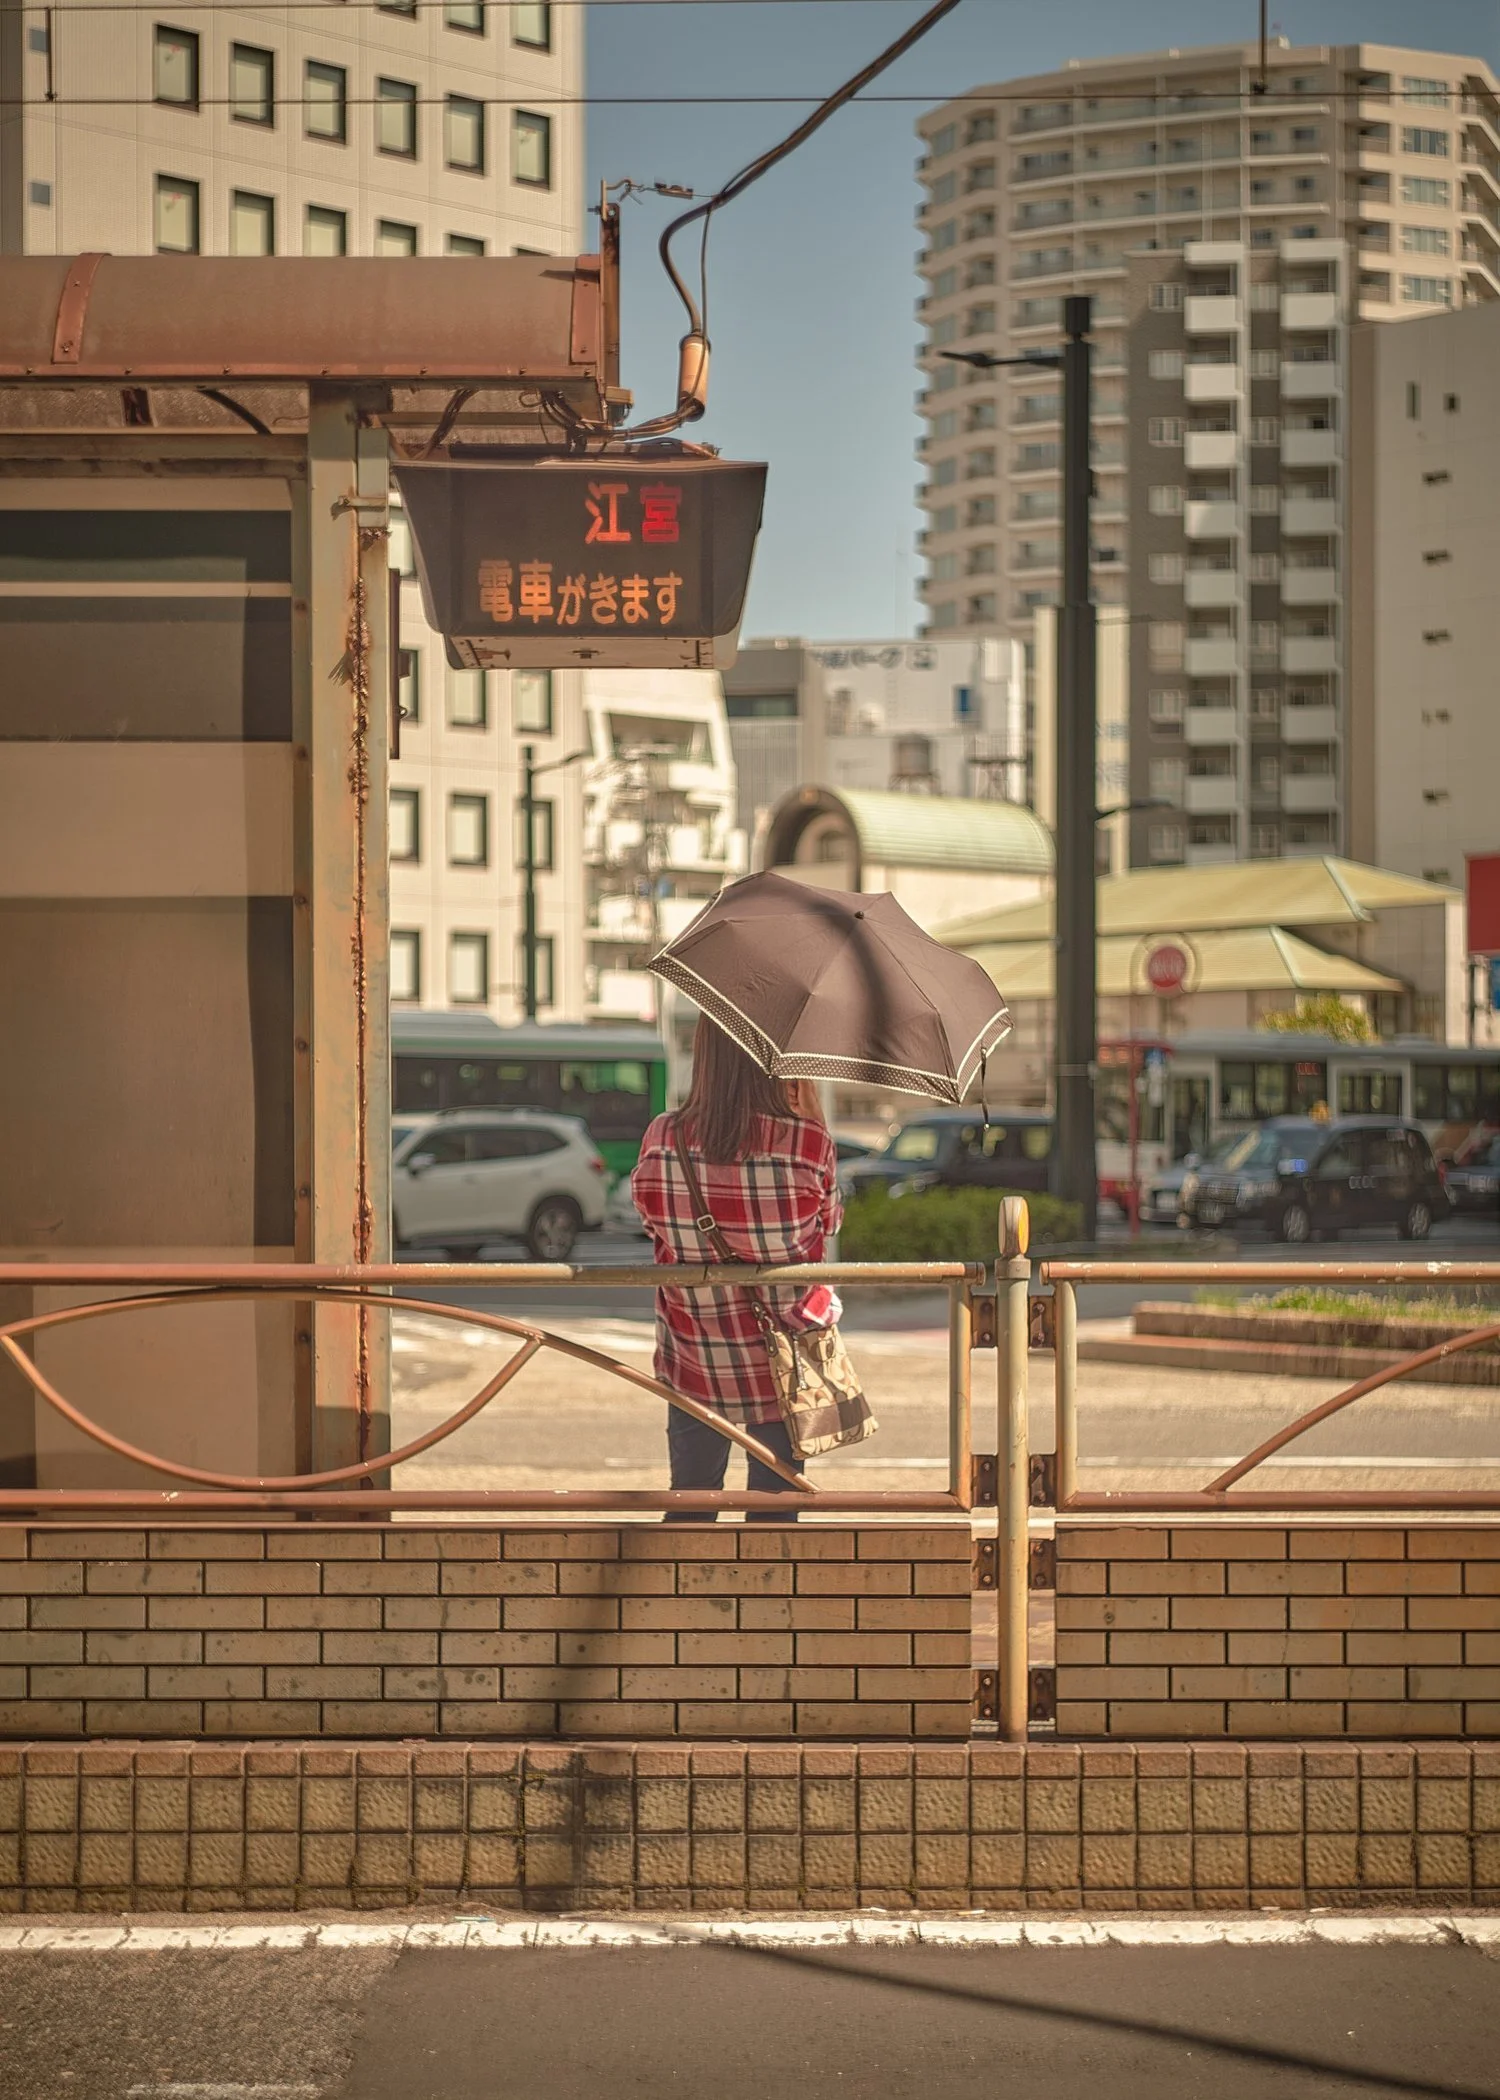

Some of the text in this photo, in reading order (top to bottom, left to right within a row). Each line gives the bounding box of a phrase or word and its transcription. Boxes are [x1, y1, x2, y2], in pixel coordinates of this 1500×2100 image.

[478, 558, 684, 625] 電車がきます
